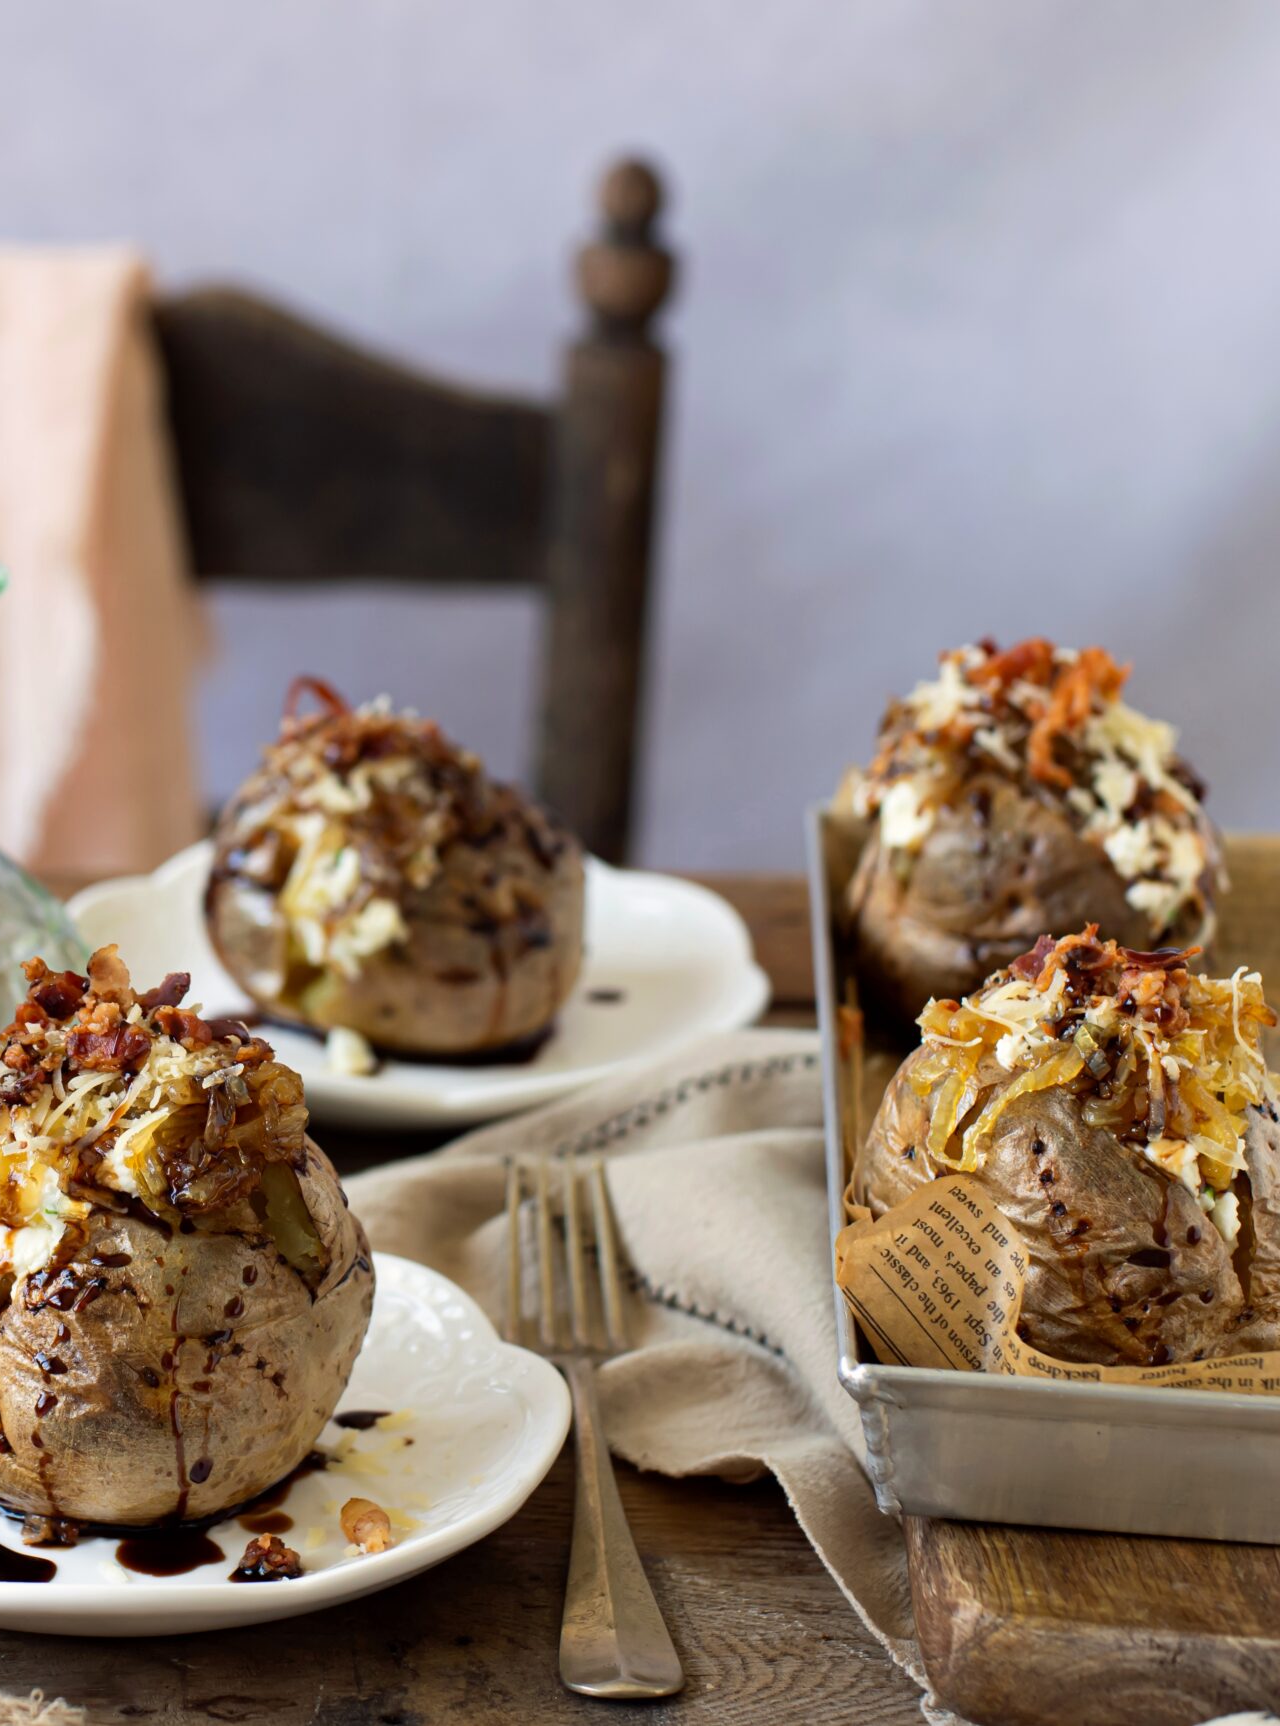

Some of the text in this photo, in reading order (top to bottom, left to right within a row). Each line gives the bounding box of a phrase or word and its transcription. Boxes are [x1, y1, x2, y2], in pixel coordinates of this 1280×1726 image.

[947, 1185, 984, 1219] sweet
[928, 1200, 982, 1256] excellent
[981, 1221, 1009, 1248] and
[880, 1248, 920, 1292] classic
[905, 1244, 932, 1270] and
[984, 1258, 1002, 1278] an
[911, 1218, 1006, 1324] the paper's most
[918, 1291, 937, 1316] the
[931, 1269, 962, 1311] 1963,
[930, 1313, 949, 1330] of
[963, 1310, 993, 1347] Sept.
[992, 1345, 1003, 1364] in
[1027, 1355, 1102, 1382] backdrop
[1207, 1377, 1233, 1390] the
[1237, 1377, 1254, 1391] in
